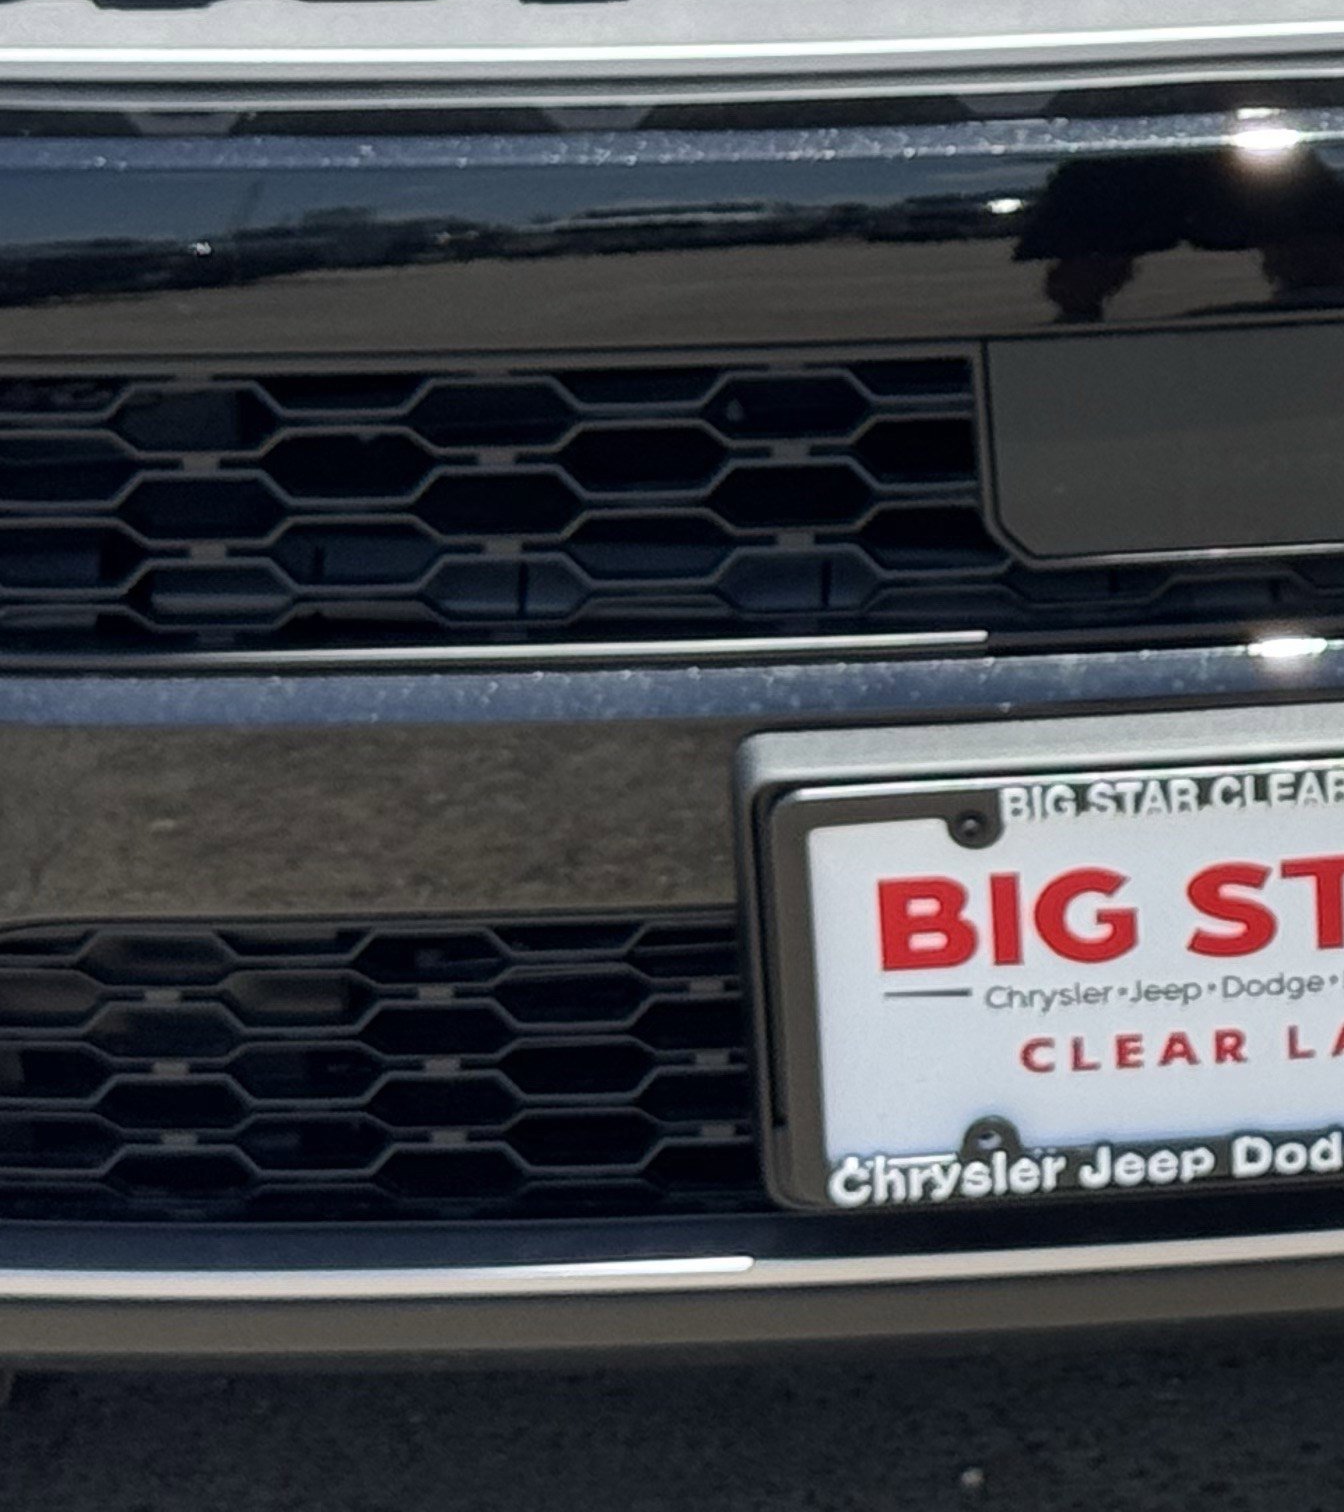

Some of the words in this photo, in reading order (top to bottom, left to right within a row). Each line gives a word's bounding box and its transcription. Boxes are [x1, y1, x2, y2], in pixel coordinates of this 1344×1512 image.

[1000, 784, 1076, 823] BIG
[1087, 777, 1200, 817] STAR
[876, 866, 1138, 971] BIG
[985, 982, 1113, 1013] Chrysler
[1129, 979, 1201, 1005] Jeep
[1221, 972, 1325, 1000] Dodge
[1020, 1028, 1247, 1074] CLEAR
[828, 1150, 1067, 1208] Chrysler
[1079, 1144, 1216, 1189] Jeep
